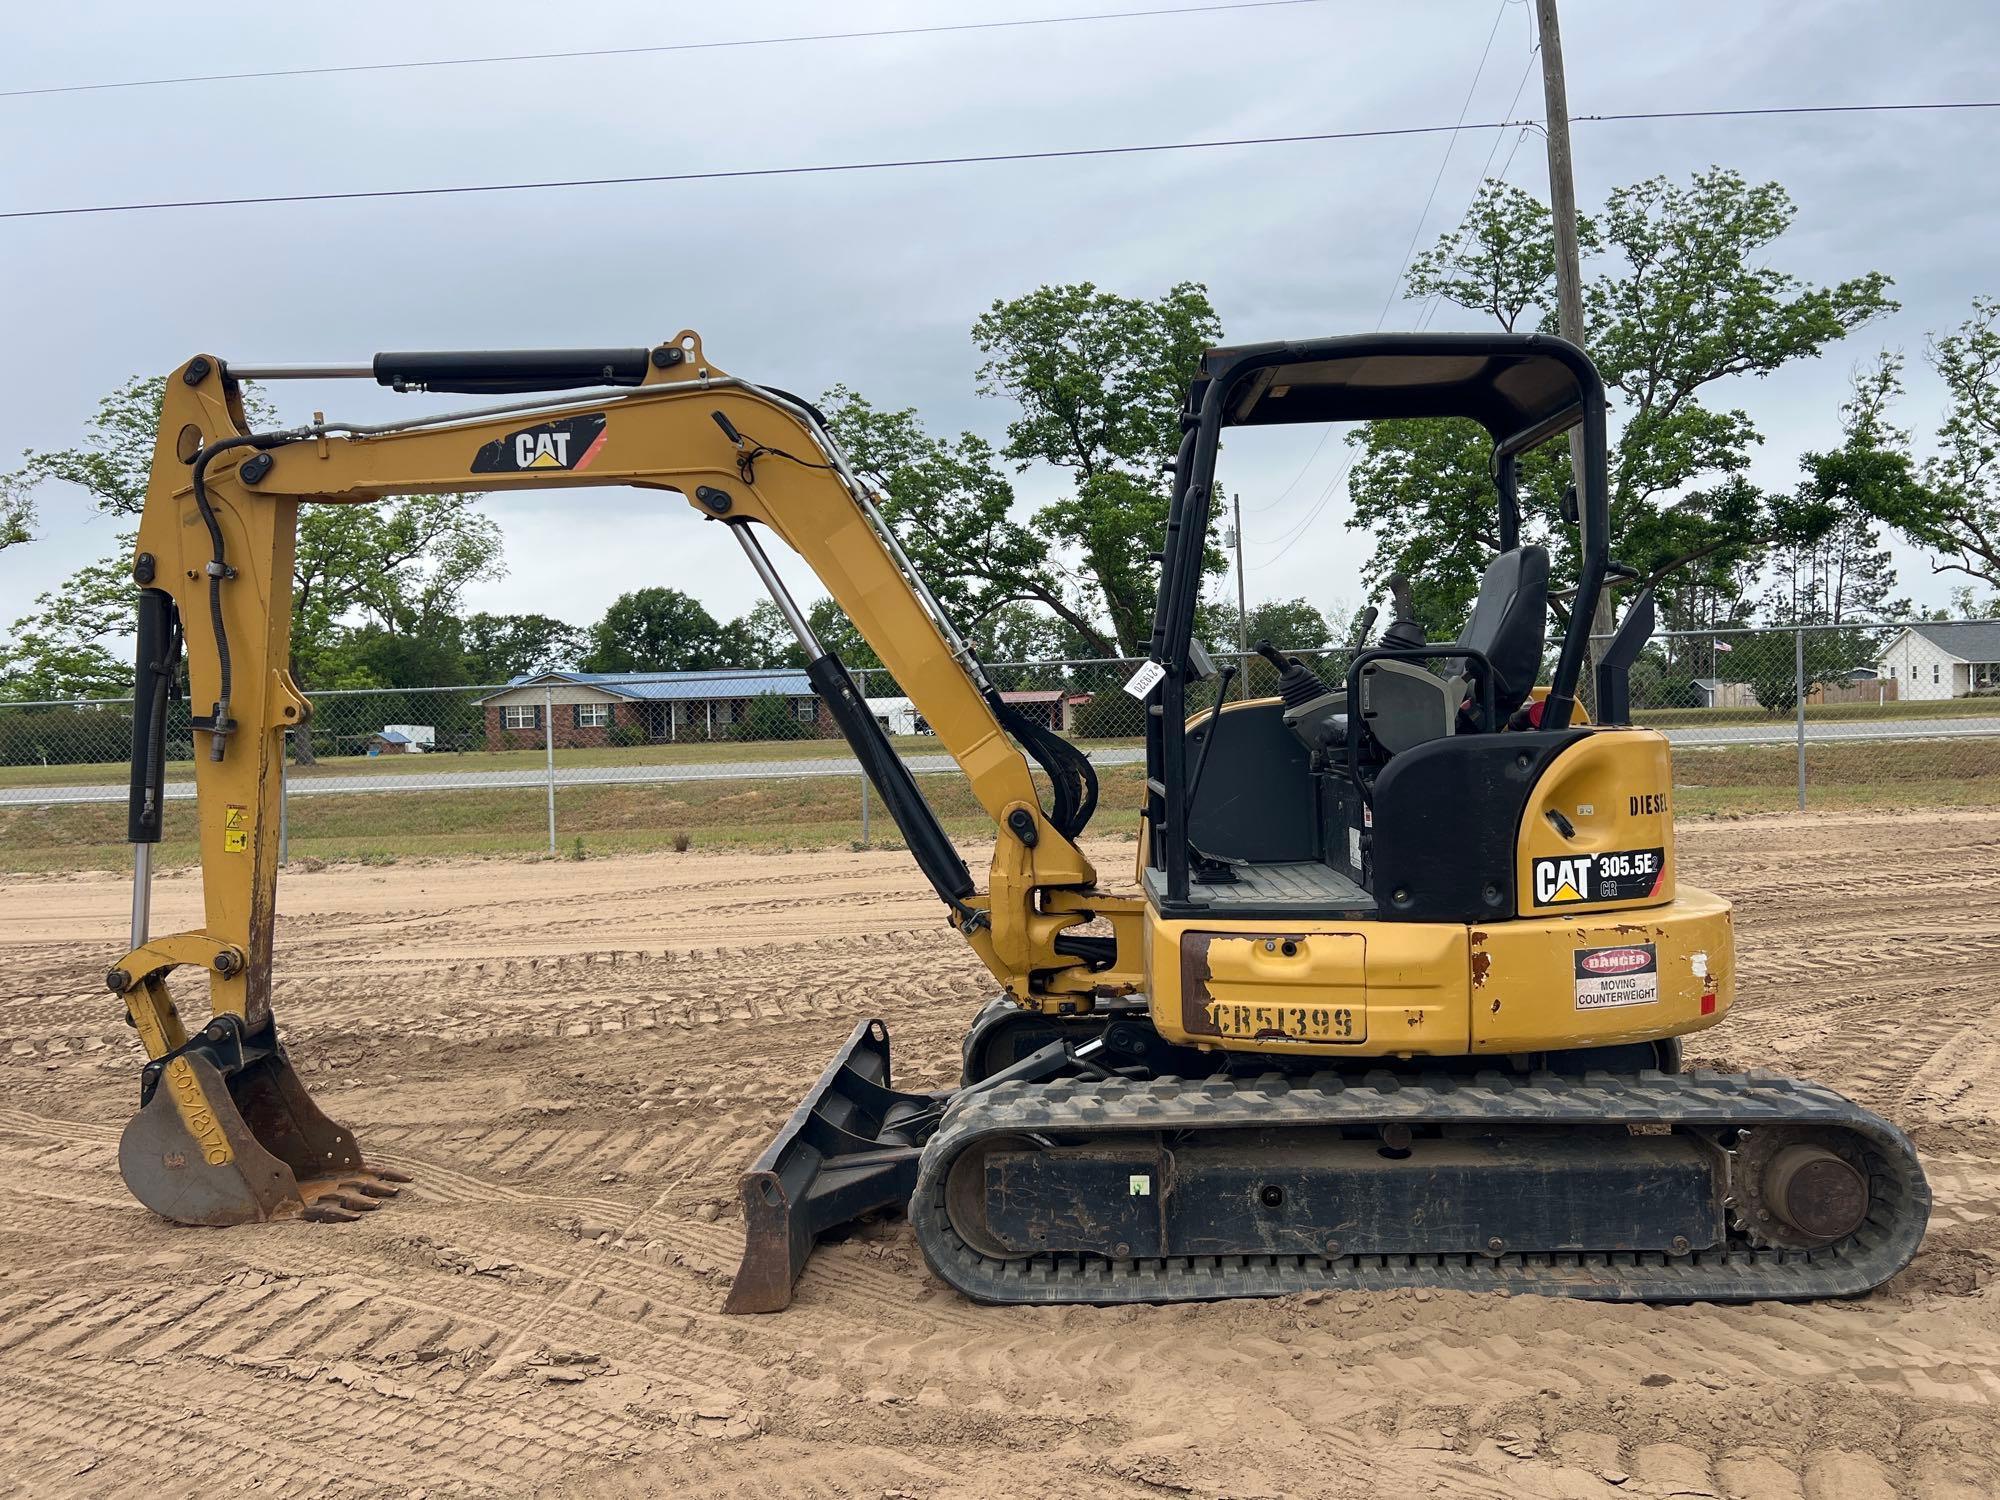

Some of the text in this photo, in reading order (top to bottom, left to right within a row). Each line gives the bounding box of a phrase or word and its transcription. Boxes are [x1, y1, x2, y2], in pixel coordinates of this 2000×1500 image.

[515, 432, 571, 468] CAT
[1133, 669, 1158, 693] 219320
[1629, 793, 1668, 816] DIESEL
[1536, 858, 1592, 903] CAT
[1600, 881, 1618, 898] CR
[1588, 954, 1645, 969] DANGER
[1600, 978, 1636, 991] MOVING
[1578, 988, 1656, 1005] COUNTERWEIGHT
[1213, 1004, 1352, 1037] CR51399
